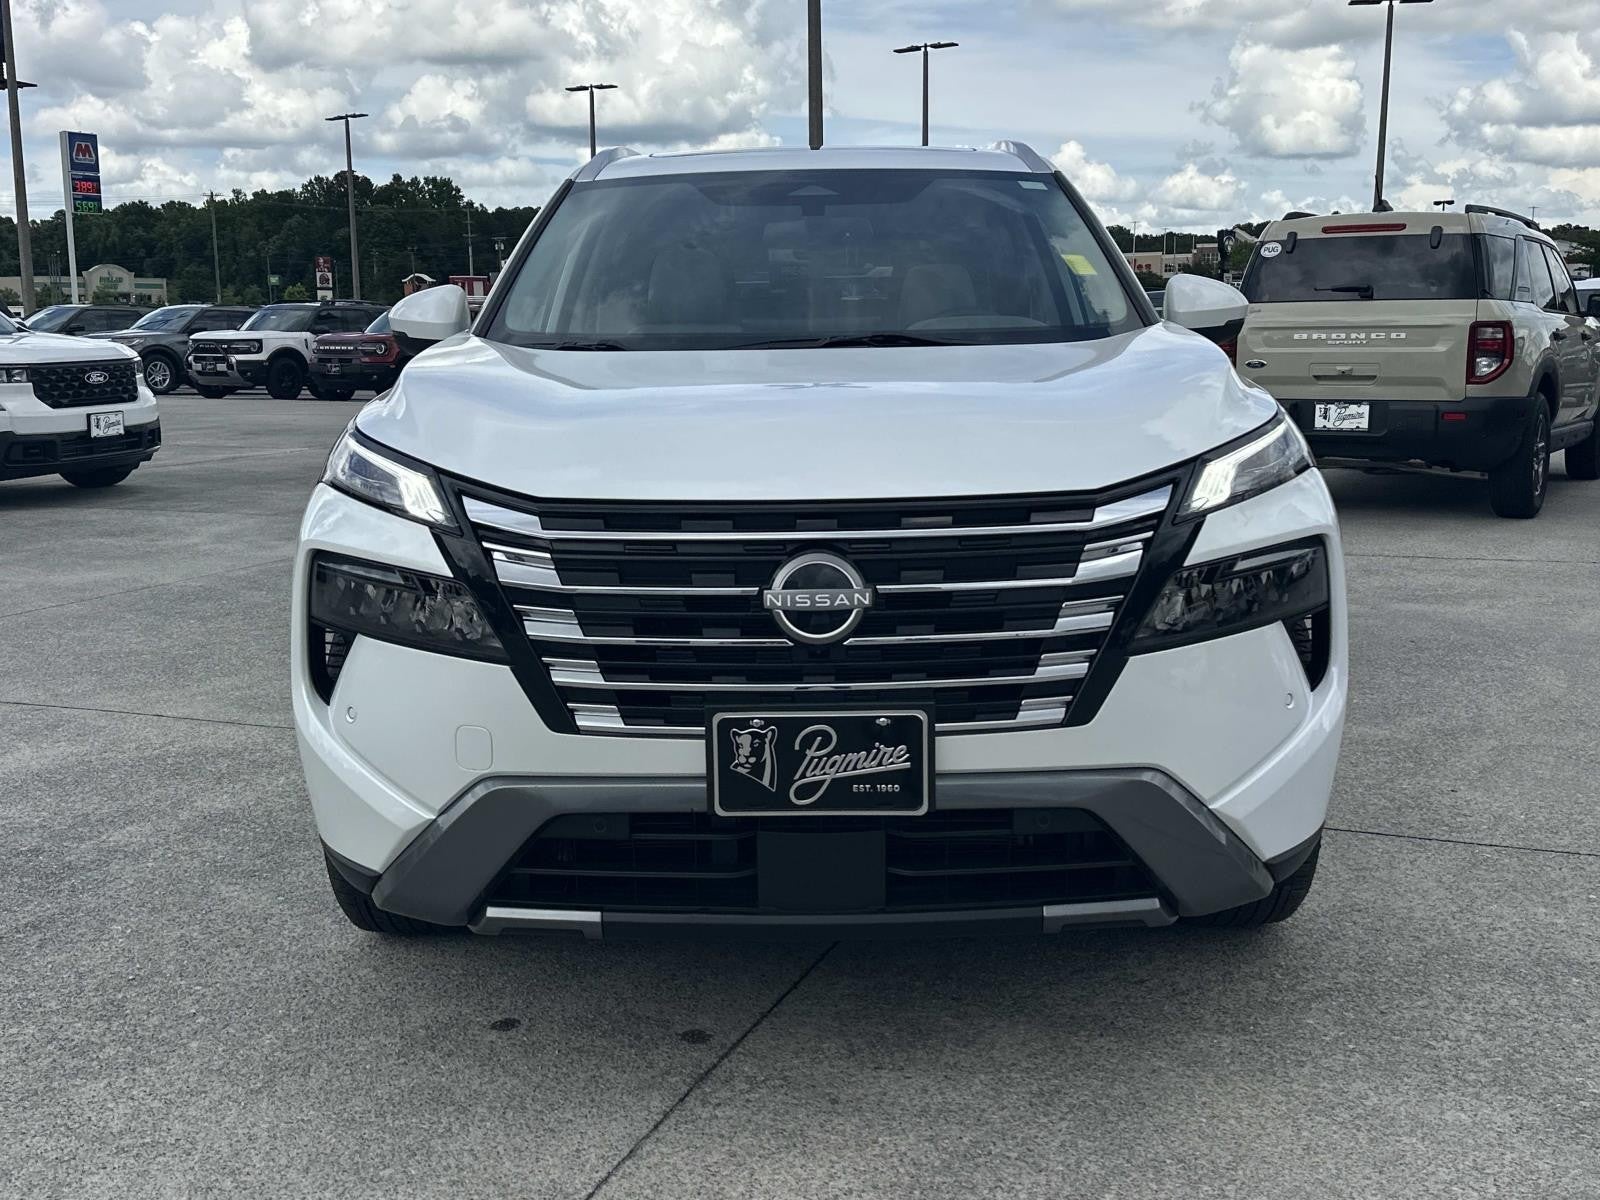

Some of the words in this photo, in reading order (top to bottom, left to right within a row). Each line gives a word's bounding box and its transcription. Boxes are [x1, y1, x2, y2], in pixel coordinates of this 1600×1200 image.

[1293, 332, 1406, 340] BRONCO
[766, 592, 870, 607] NISSAN
[789, 724, 911, 806] Pugmire
[852, 784, 873, 792] EST.
